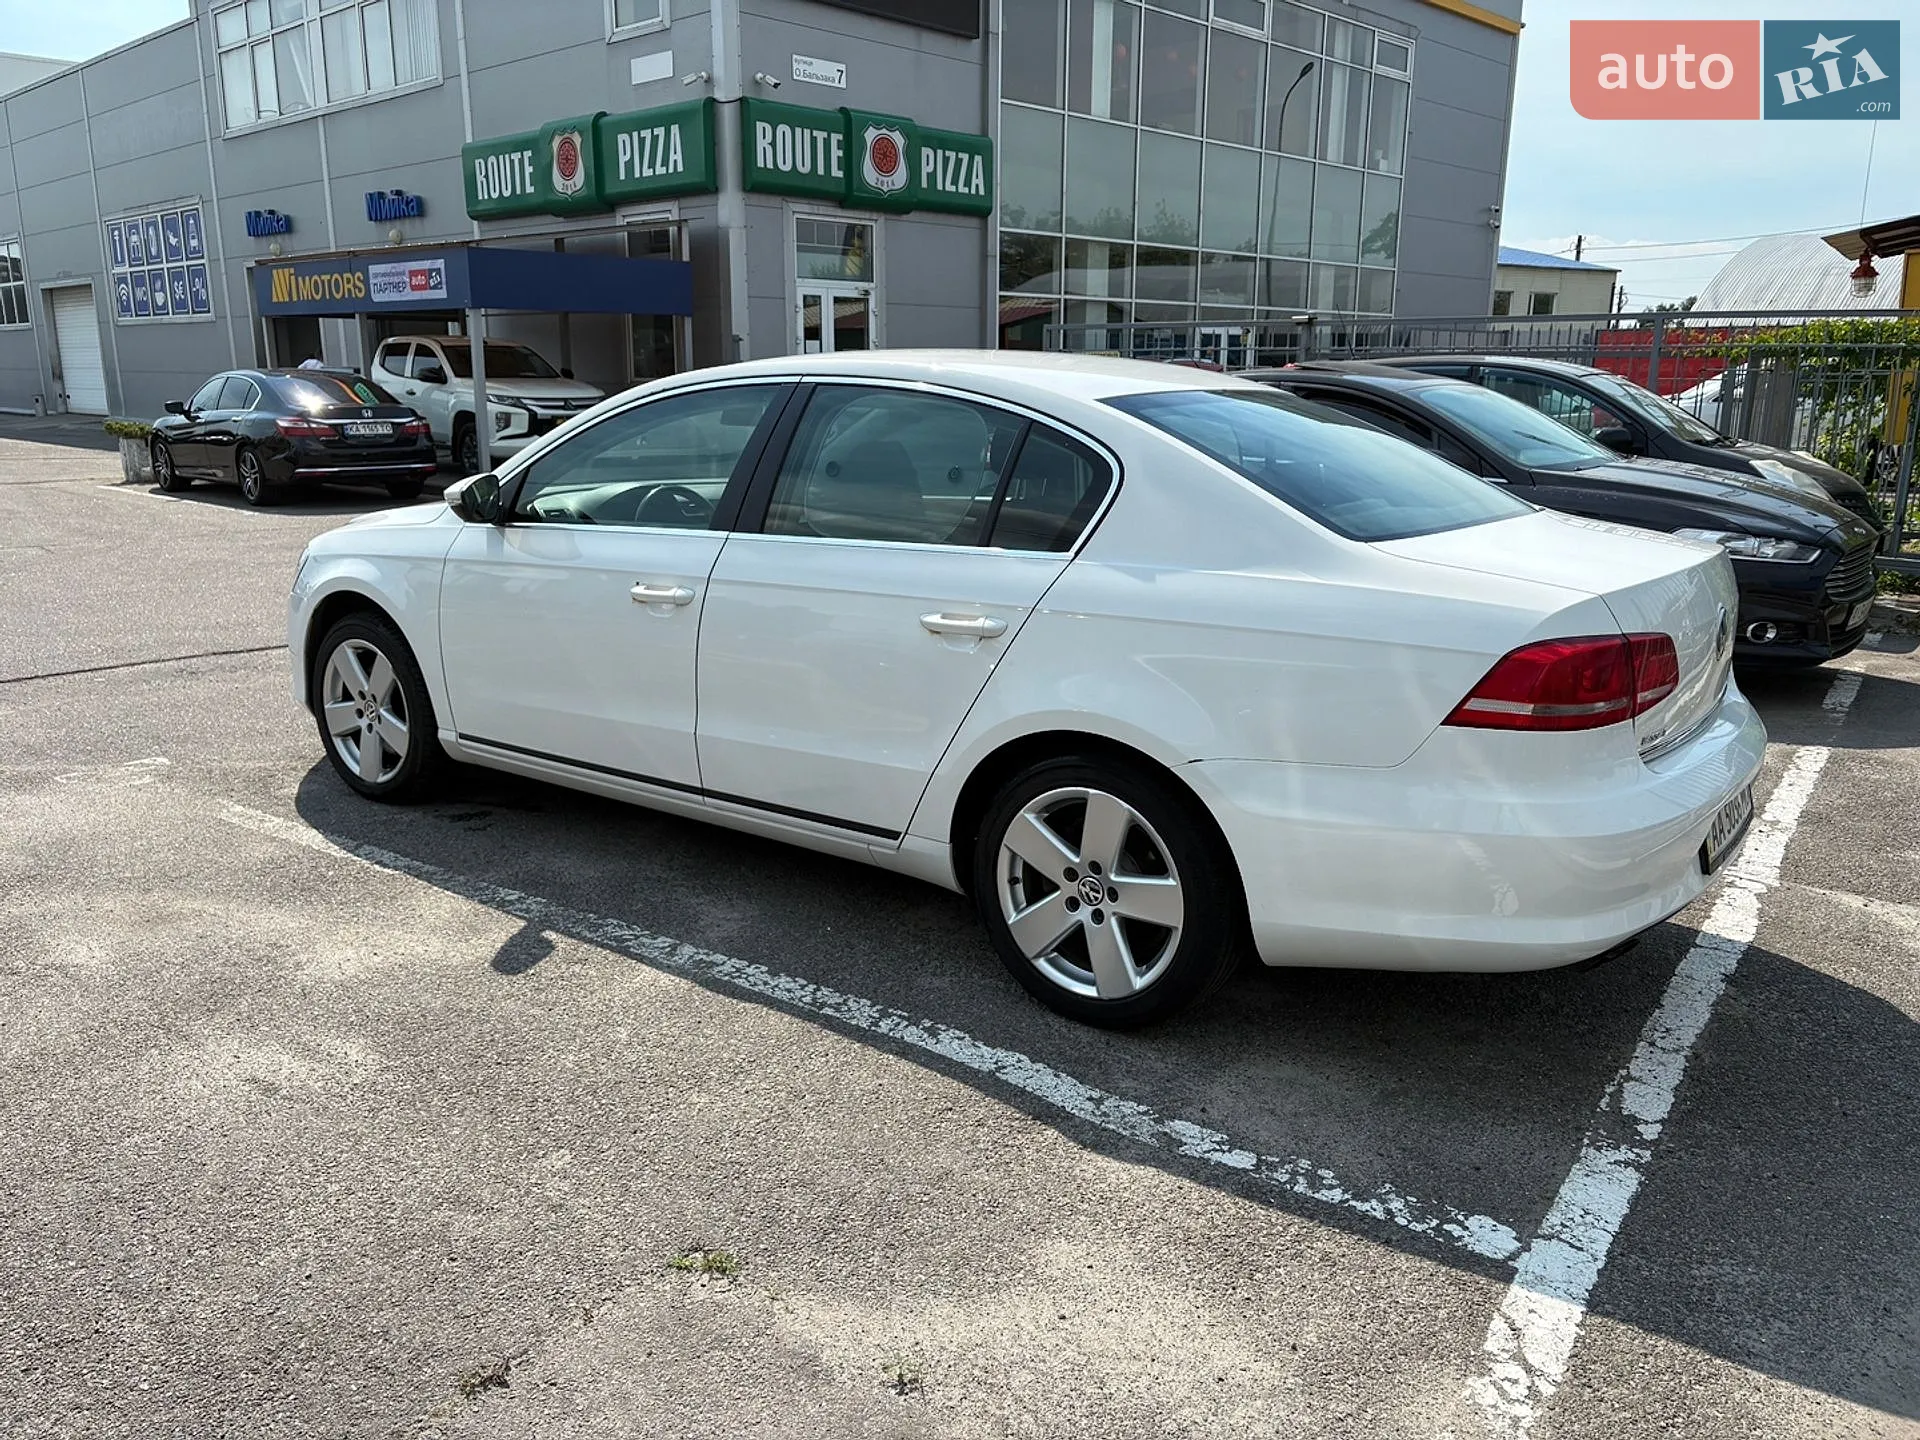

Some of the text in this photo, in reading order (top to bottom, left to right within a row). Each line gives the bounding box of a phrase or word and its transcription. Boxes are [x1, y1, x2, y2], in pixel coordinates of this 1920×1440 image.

[836, 69, 844, 84] 7
[617, 124, 684, 180] PIZZA
[755, 121, 844, 178] ROUTE
[475, 150, 535, 200] ROUTE
[921, 146, 985, 196] PIZZA
[245, 209, 290, 237] Мийка
[364, 190, 422, 222] Мийка
[298, 271, 365, 301] MOTORS
